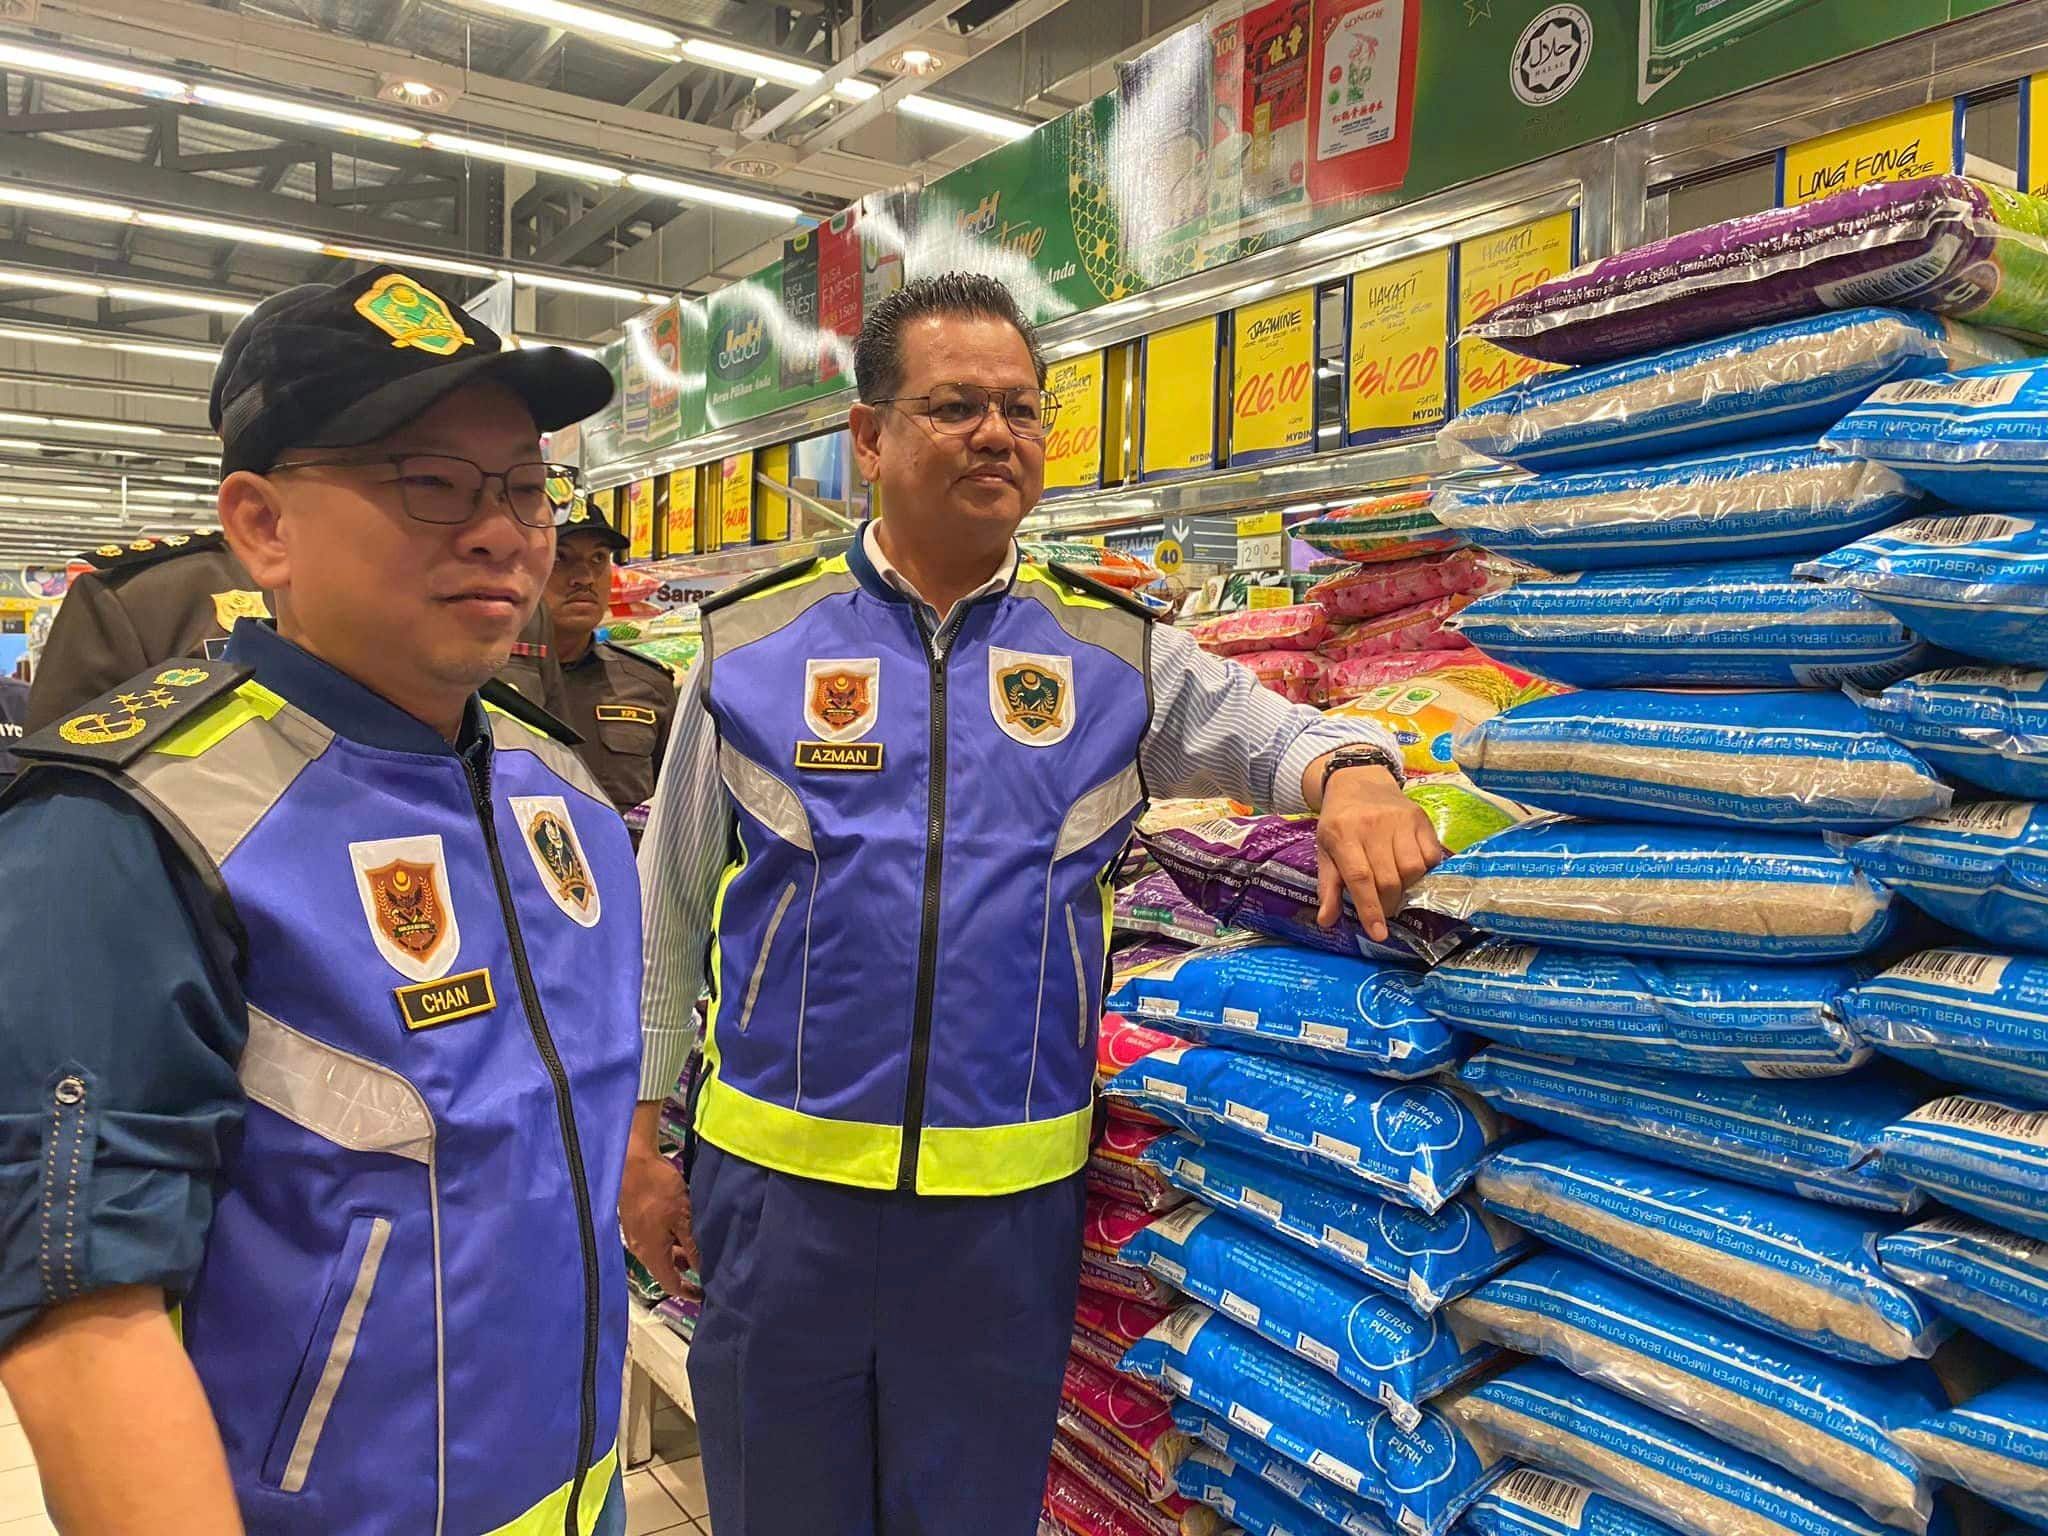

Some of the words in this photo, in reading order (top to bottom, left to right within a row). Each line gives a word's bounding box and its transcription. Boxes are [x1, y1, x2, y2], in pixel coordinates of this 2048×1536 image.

[1797, 160, 1849, 198] LONG
[1855, 139, 1921, 179] FONG
[1368, 269, 1421, 308] HAYATI
[1247, 309, 1302, 341] JASMINE
[1354, 346, 1439, 400] 31.20
[1235, 361, 1310, 419] 26.00
[1996, 423, 2041, 434] PUTIH
[1045, 426, 1098, 462] 26.00
[1670, 520, 1705, 532] BERAS
[1160, 549, 1178, 564] 40
[1944, 560, 1993, 575] BERAS
[1999, 564, 2044, 575] PUTIH
[1720, 595, 1752, 605] PUTIH
[1624, 730, 1658, 741] BERAS
[811, 749, 868, 764] AZMAN
[1676, 864, 1712, 874] SUPER
[421, 985, 470, 1014] CHAN
[1697, 1012, 1734, 1024] SUPER
[1934, 1009, 1982, 1029] BERAS
[1984, 1019, 2029, 1038] PUTIH
[1397, 1111, 1432, 1131] PUTIH
[1402, 1098, 1443, 1126] BERAS
[1566, 1085, 1597, 1099] PUTIH
[1724, 1121, 1758, 1139] PUTIH
[1759, 1131, 1799, 1149] SUPER
[1598, 1196, 1630, 1214] PUTIH
[1630, 1206, 1666, 1225] BERAS
[1715, 1231, 1754, 1255] SUPER
[1754, 1246, 1789, 1268] PUTIH
[1924, 1253, 1988, 1282] (IMPORT)
[1987, 1275, 2041, 1304] BERAS
[1376, 1307, 1413, 1335] BERAS
[1564, 1308, 1597, 1328] SUPER
[1369, 1319, 1402, 1344] PUTIH
[1625, 1331, 1662, 1354] BERAS
[1710, 1366, 1751, 1390] SUPER
[1946, 1420, 1997, 1444] BERAS
[1389, 1435, 1424, 1467] PUTIH
[1629, 1443, 1665, 1465] BERAS
[1714, 1479, 1752, 1503] SUPER
[1750, 1494, 1788, 1518] PUTIH
